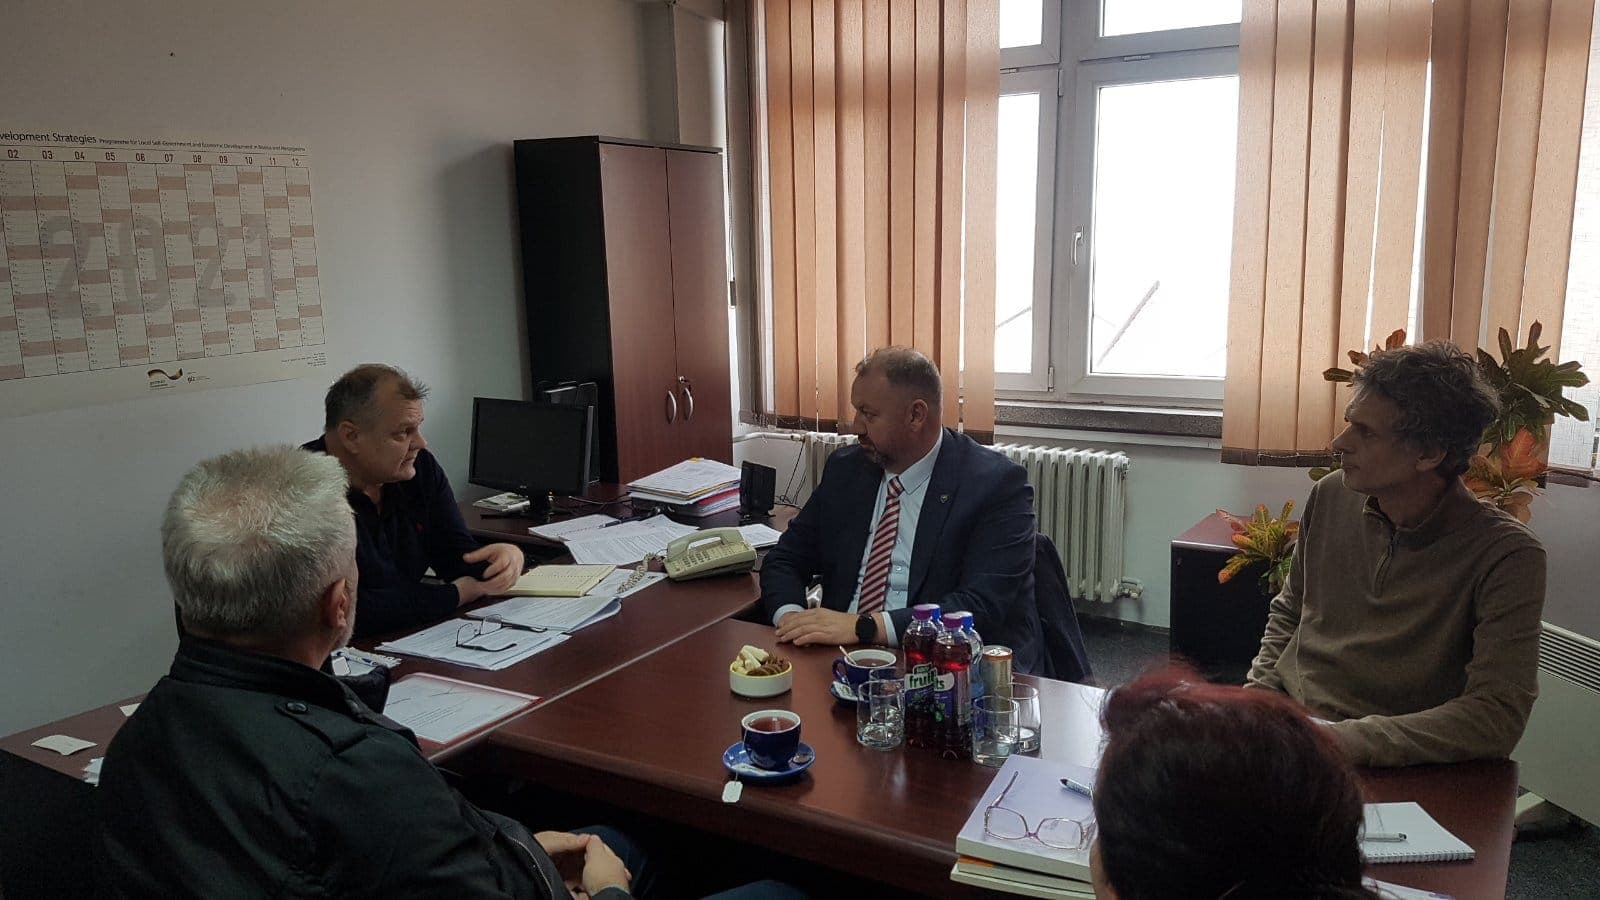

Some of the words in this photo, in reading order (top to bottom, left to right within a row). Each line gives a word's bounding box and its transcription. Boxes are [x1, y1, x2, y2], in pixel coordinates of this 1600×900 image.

[52, 132, 97, 145] Strategies
[7, 149, 19, 159] 02
[42, 150, 53, 160] 03
[74, 151, 86, 161] 04
[105, 152, 116, 161] 05
[135, 152, 146, 162] 06
[164, 153, 174, 163] 07
[192, 154, 202, 164] 08
[219, 155, 229, 164] 09
[244, 156, 254, 165] 10
[269, 157, 277, 166] 11
[292, 158, 301, 167] 12
